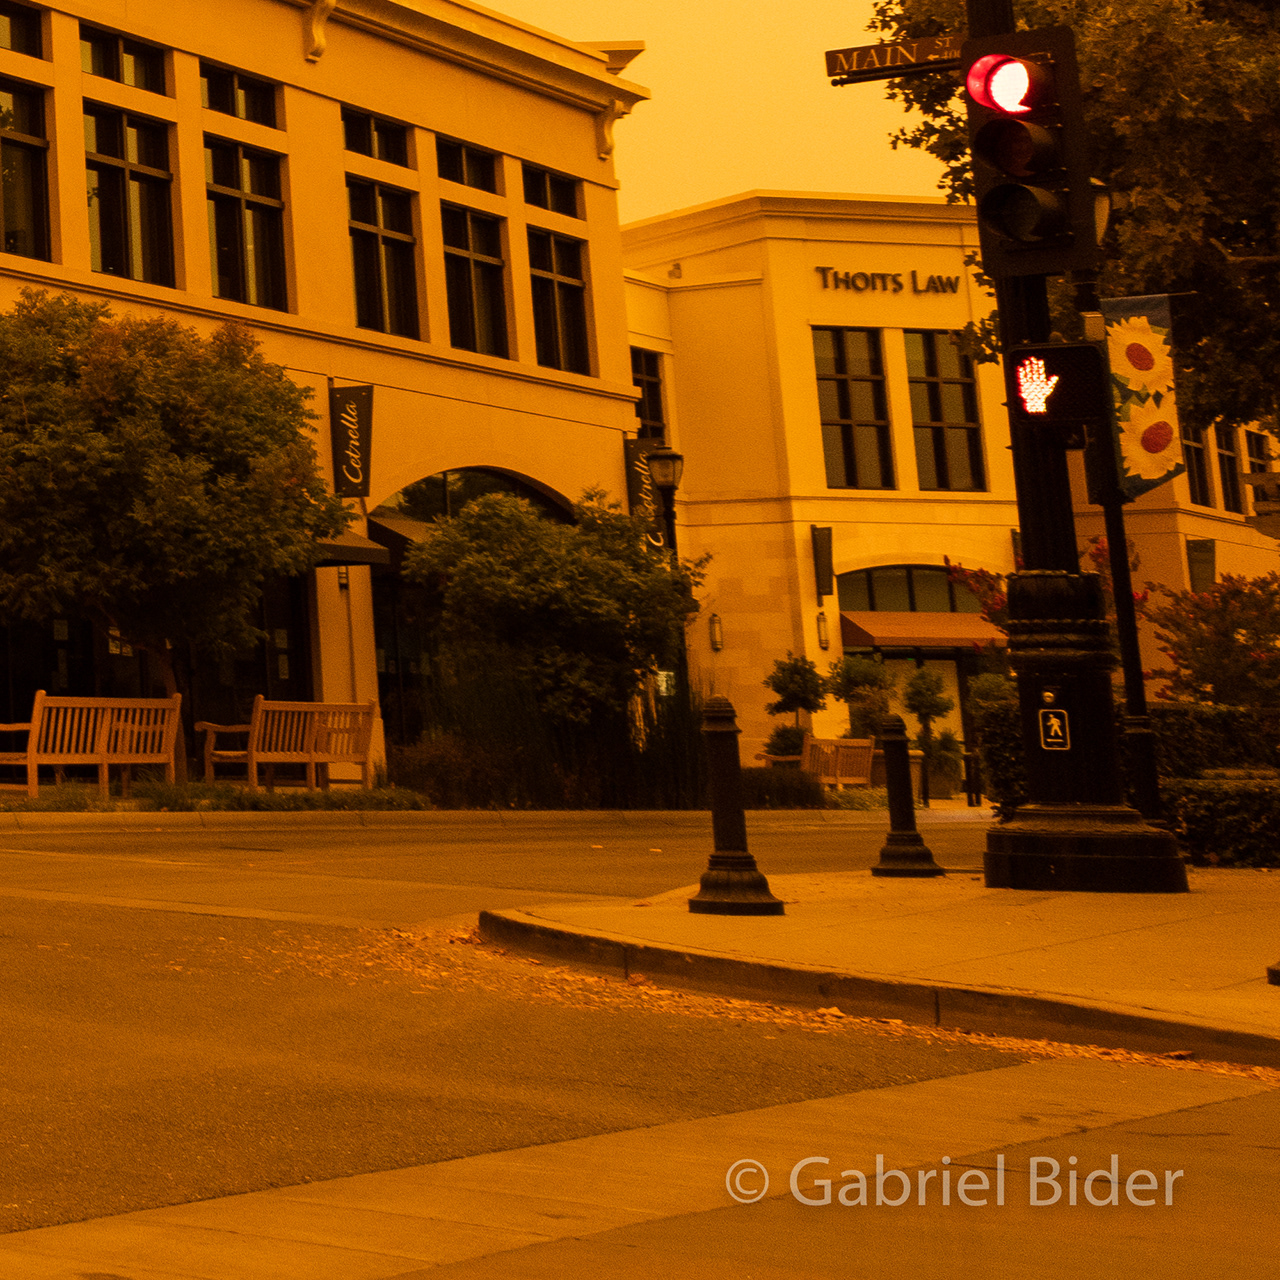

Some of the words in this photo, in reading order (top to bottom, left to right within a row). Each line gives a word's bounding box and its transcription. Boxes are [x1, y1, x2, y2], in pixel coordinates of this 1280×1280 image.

[934, 36, 954, 48] ST
[835, 43, 919, 73] MAIN
[911, 270, 961, 294] LAW
[340, 400, 363, 483] Cetrella
